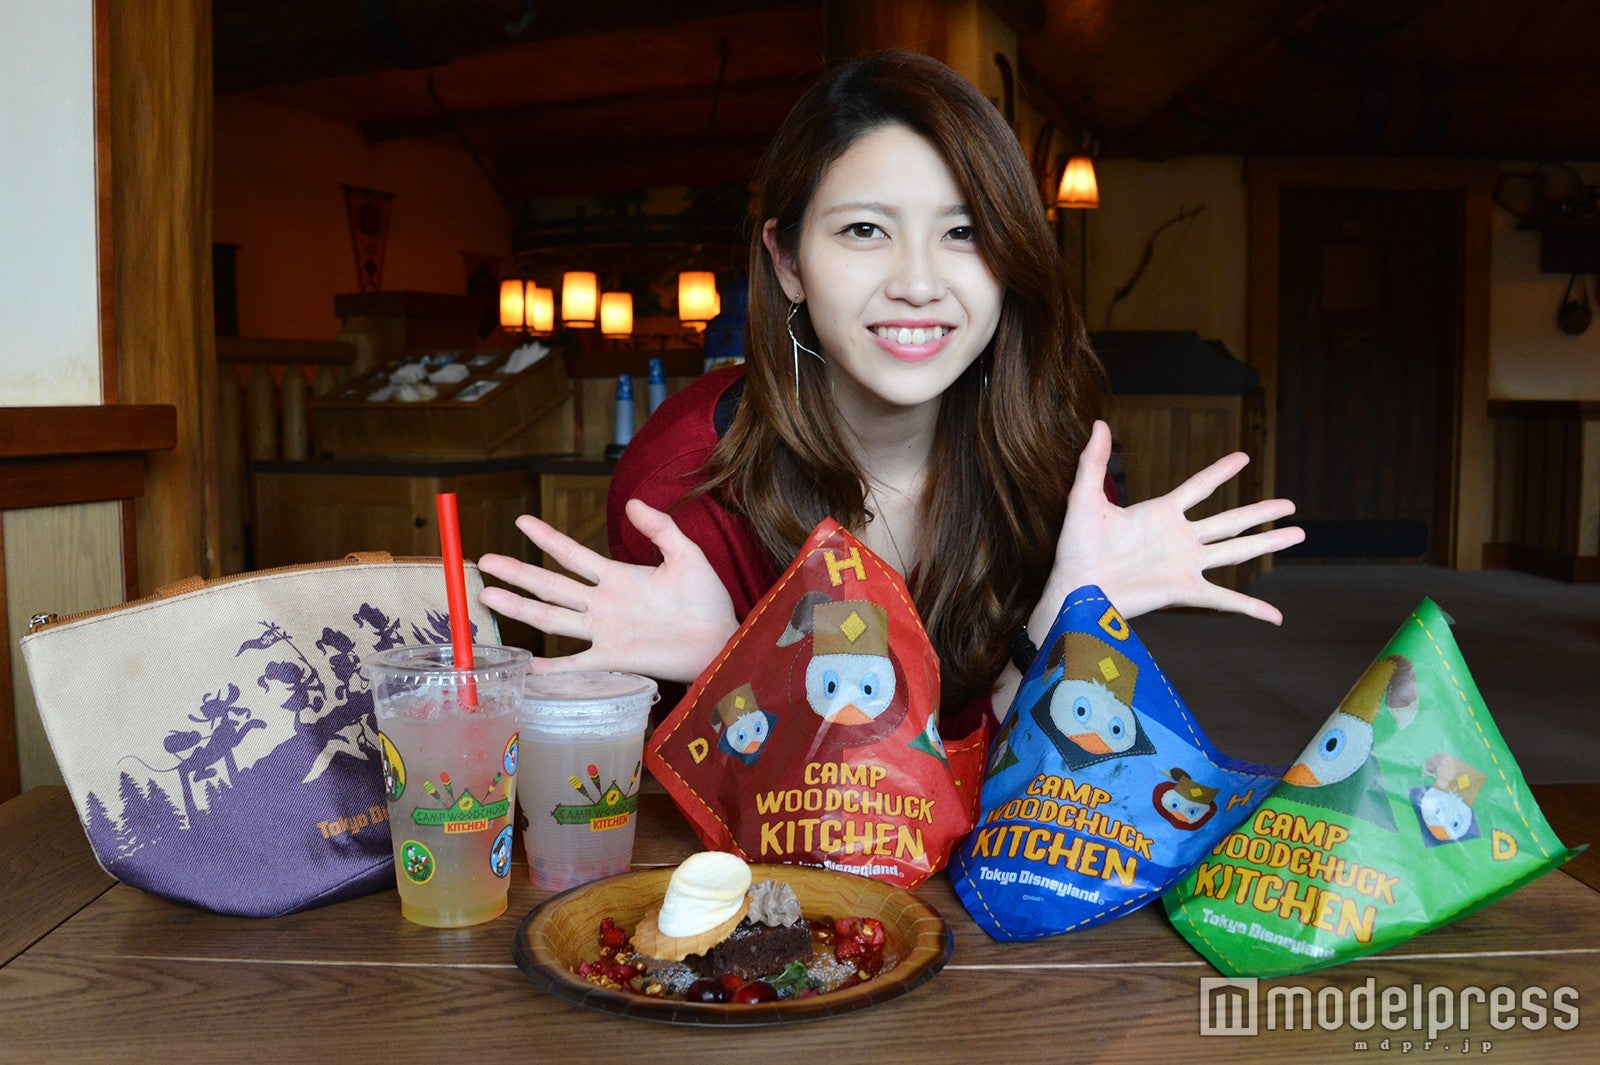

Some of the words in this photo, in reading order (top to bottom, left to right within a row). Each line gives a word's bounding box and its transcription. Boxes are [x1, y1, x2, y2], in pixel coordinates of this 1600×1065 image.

[824, 547, 867, 586] H
[1097, 606, 1130, 641] D
[688, 737, 709, 764] D
[804, 762, 886, 788] CAMP
[1027, 774, 1112, 809] CAMP
[416, 811, 445, 823] CAMP
[756, 788, 936, 824] WOODCHUCK
[1225, 789, 1254, 812] H
[316, 814, 369, 840] Tokyo
[447, 820, 487, 832] KITCHEN
[593, 814, 629, 831] KITCHEN
[760, 818, 925, 861] KITCHEN
[1253, 808, 1350, 852] CAMP
[971, 825, 1138, 887] KITCHEN
[1490, 829, 1518, 861] D
[979, 866, 1018, 886] Tokyo
[1018, 870, 1100, 905] Disneyland
[1213, 832, 1400, 905] OODCHUCK
[1194, 861, 1378, 944] KITCHEN
[1202, 907, 1247, 934] Tokyo
